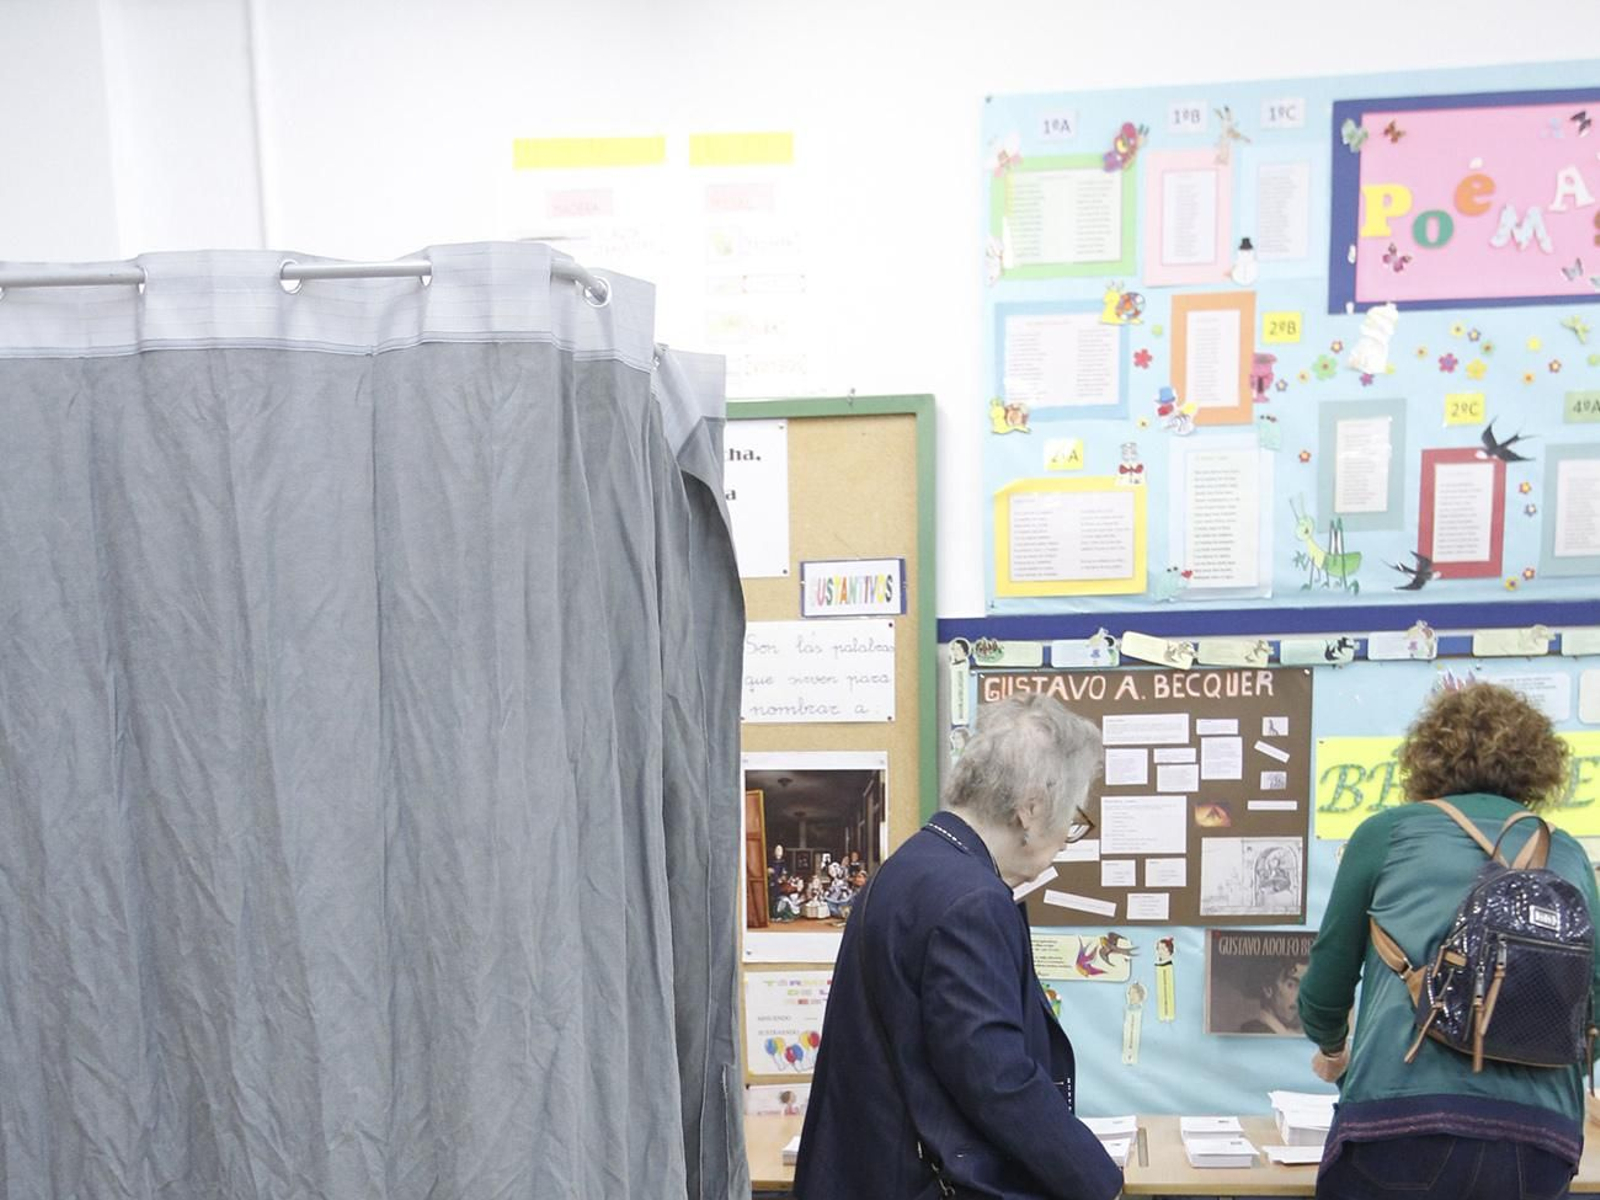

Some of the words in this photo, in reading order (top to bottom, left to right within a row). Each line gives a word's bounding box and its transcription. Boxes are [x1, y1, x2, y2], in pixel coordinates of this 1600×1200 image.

[1173, 109, 1201, 125] 1ºB
[1269, 106, 1297, 121] 1ºC
[1043, 119, 1072, 135] 1ºA
[1270, 320, 1297, 336] 2ºB
[1451, 402, 1480, 417] 2ºC
[811, 573, 893, 607] USTANTIVOS
[746, 633, 780, 655] Son
[796, 634, 823, 654] las
[745, 675, 775, 690] que
[846, 674, 890, 693] para
[984, 674, 1107, 702] GUSTAVO
[1114, 674, 1146, 700] A.
[1154, 669, 1274, 699] BECQUER
[750, 696, 841, 716] nombrar
[1219, 935, 1261, 957] GUSTAVO
[1261, 936, 1299, 957] ADOLFO
